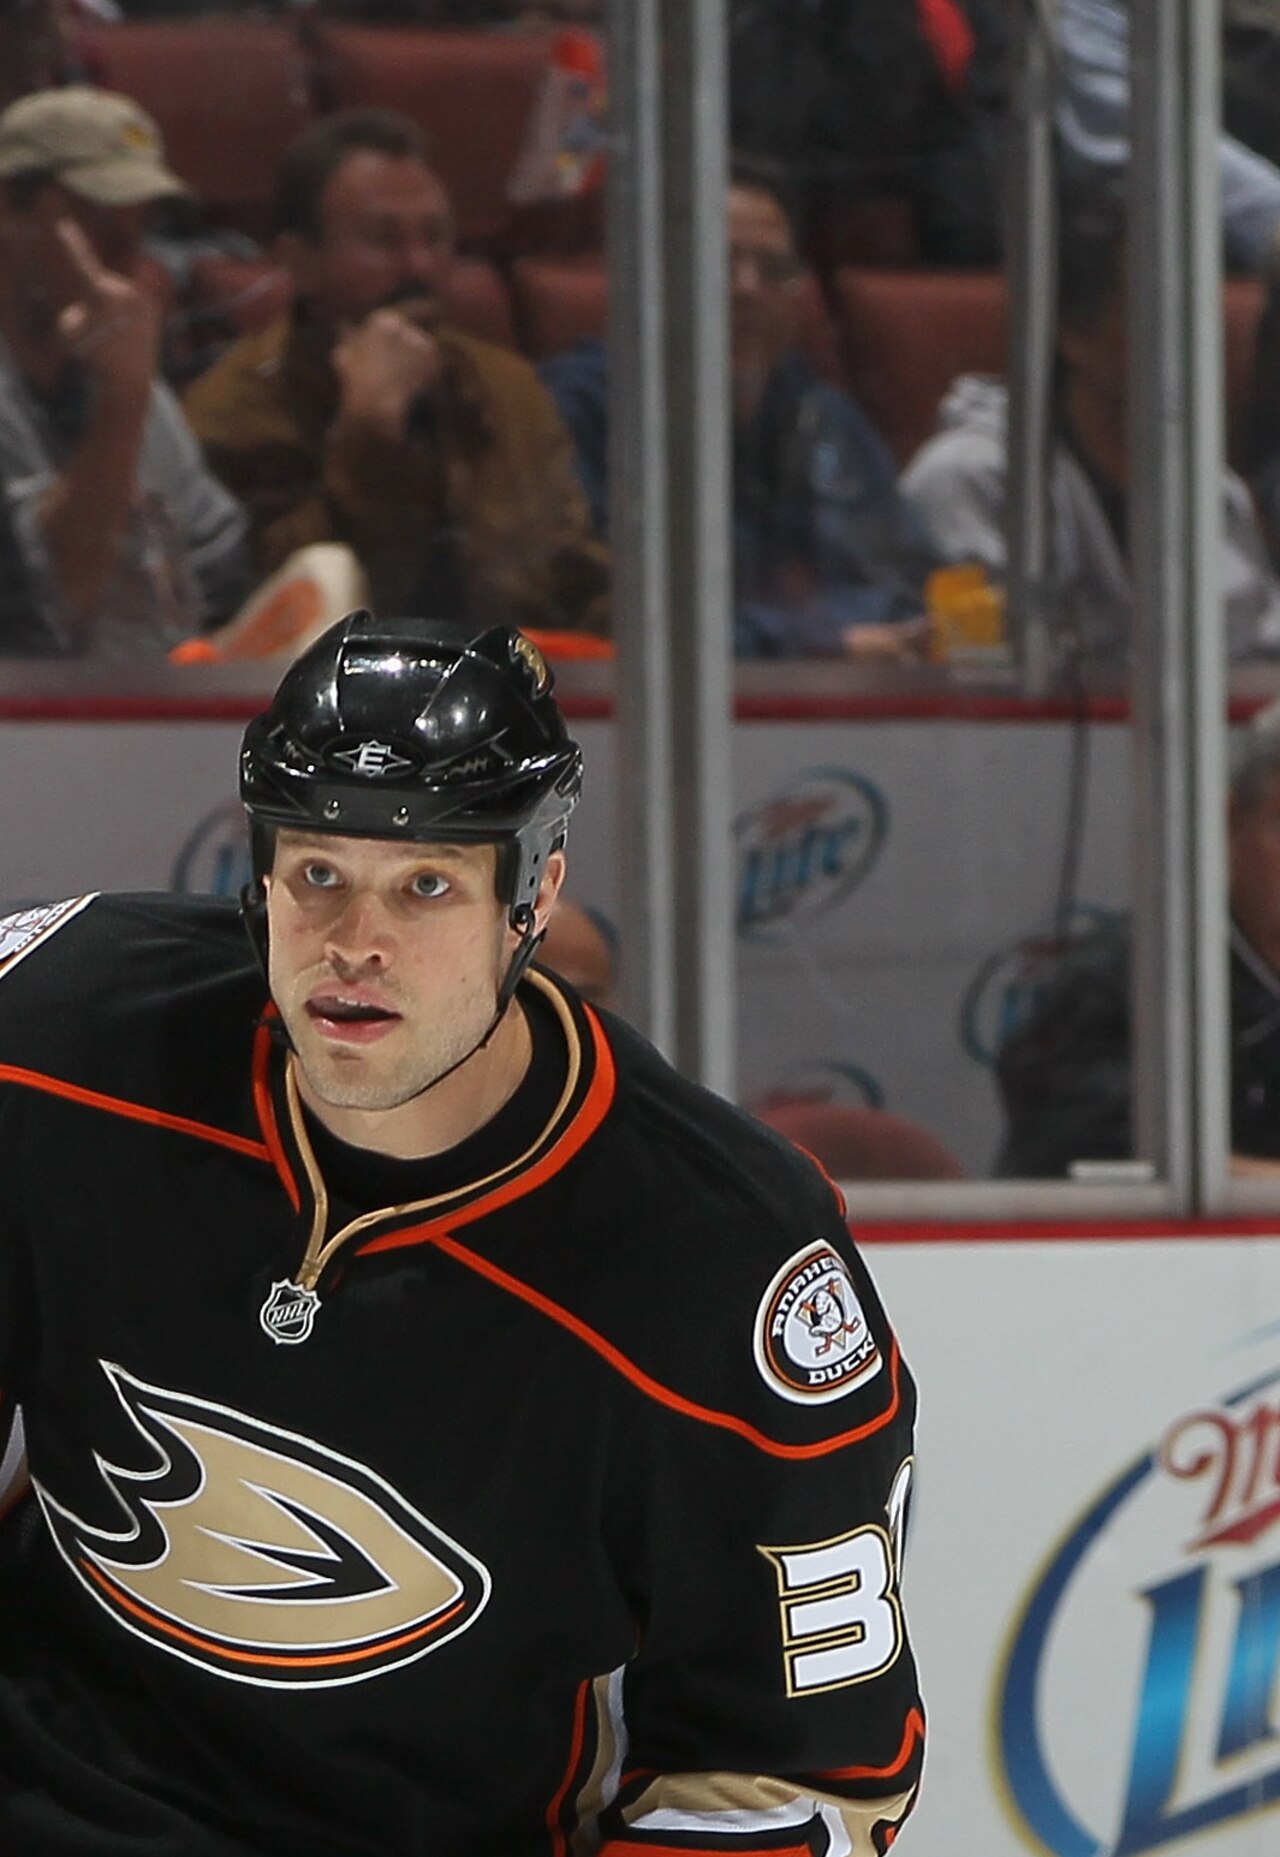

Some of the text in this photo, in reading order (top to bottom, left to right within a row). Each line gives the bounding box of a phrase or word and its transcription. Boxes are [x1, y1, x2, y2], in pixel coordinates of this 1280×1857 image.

[771, 1256, 838, 1338] ANAHE
[808, 1331, 876, 1385] DUCK
[756, 1456, 915, 1699] 3
